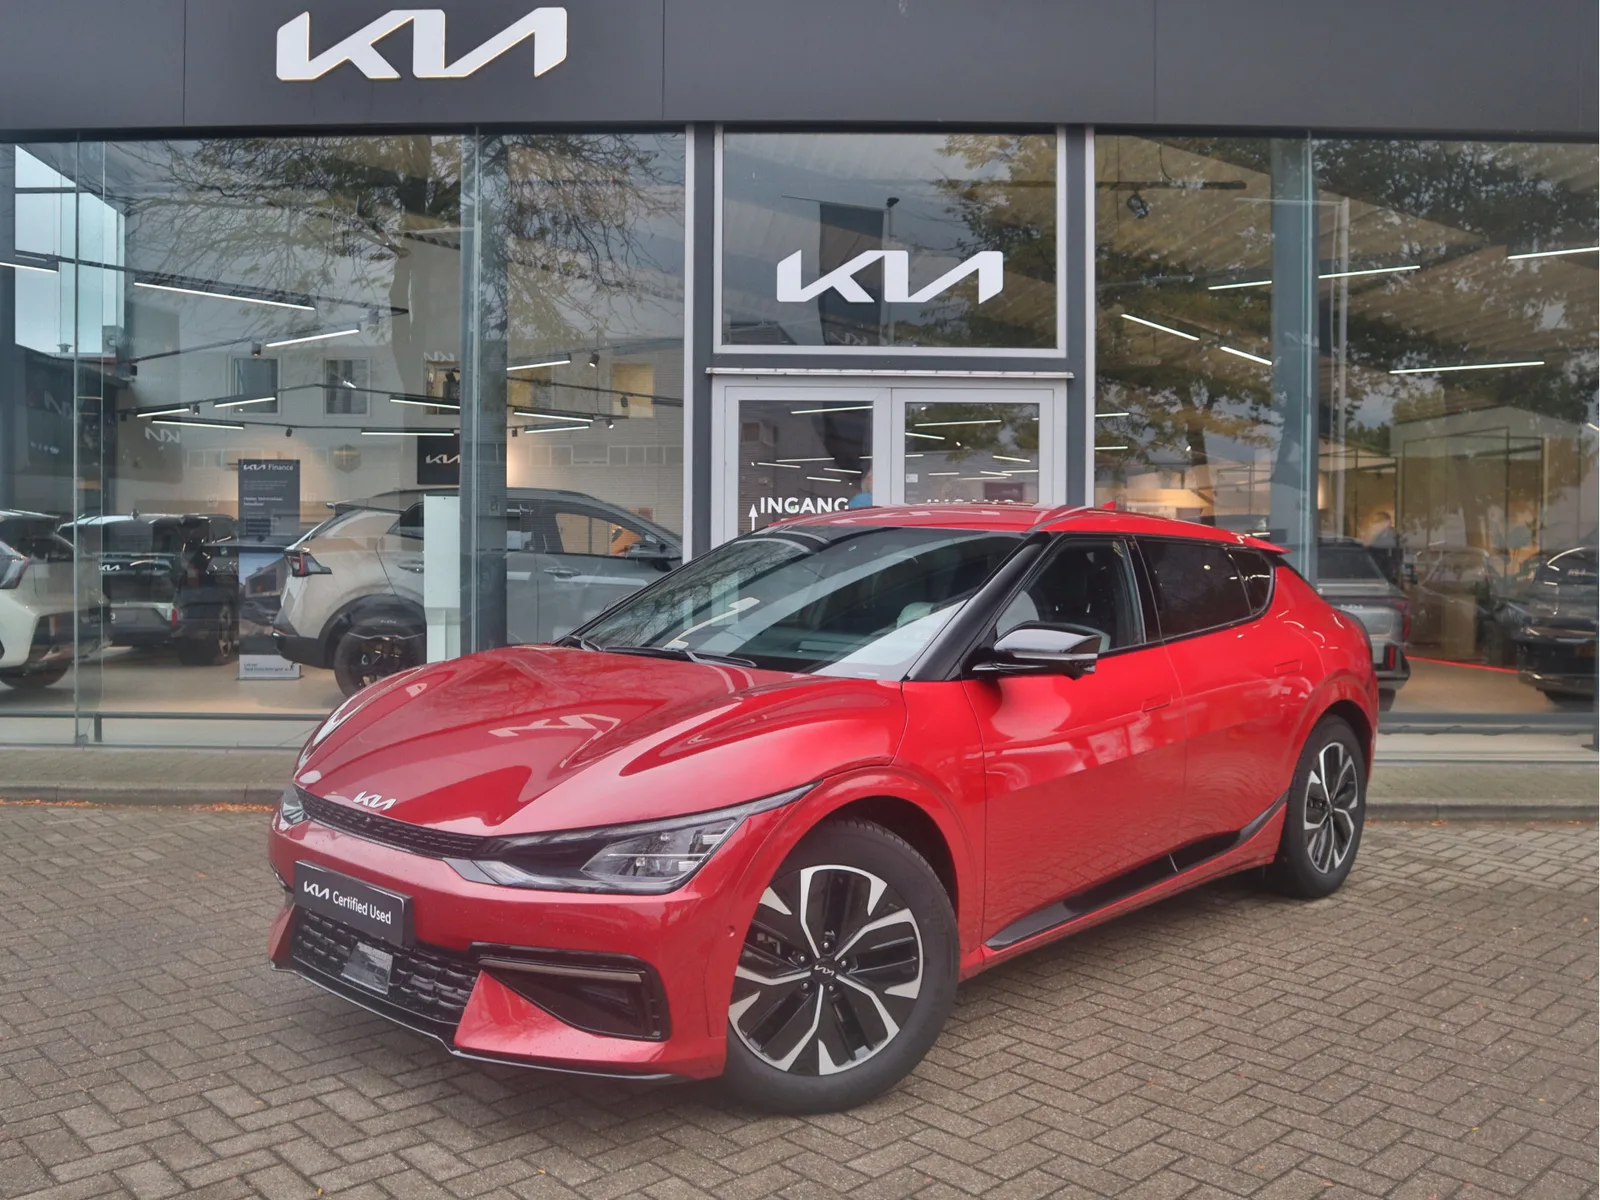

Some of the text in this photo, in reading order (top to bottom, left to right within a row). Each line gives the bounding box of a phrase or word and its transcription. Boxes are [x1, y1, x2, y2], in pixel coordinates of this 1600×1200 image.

[276, 7, 568, 81] KIA
[776, 249, 1004, 304] KIA
[760, 496, 849, 514] INGANG
[353, 791, 396, 810] KIA
[303, 880, 392, 925] KIA Certified Used
